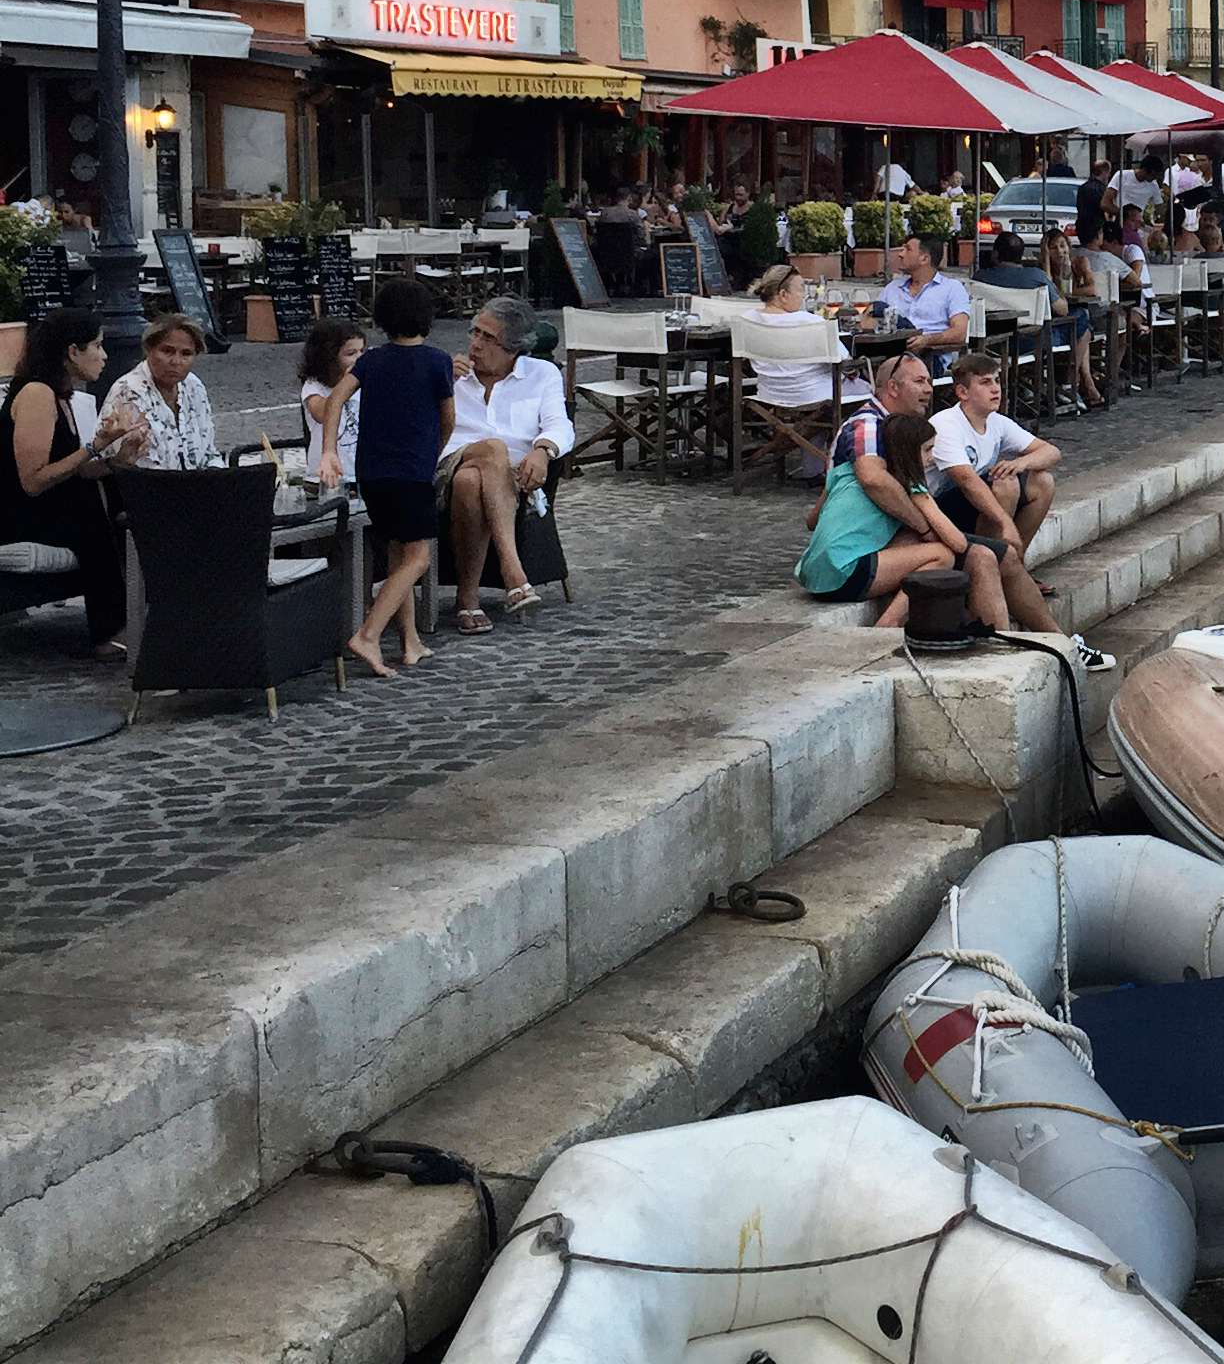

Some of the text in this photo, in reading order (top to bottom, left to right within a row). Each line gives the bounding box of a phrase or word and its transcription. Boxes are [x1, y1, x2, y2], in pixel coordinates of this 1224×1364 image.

[413, 77, 586, 95] RESTAURANT LE TRASTEVERE
